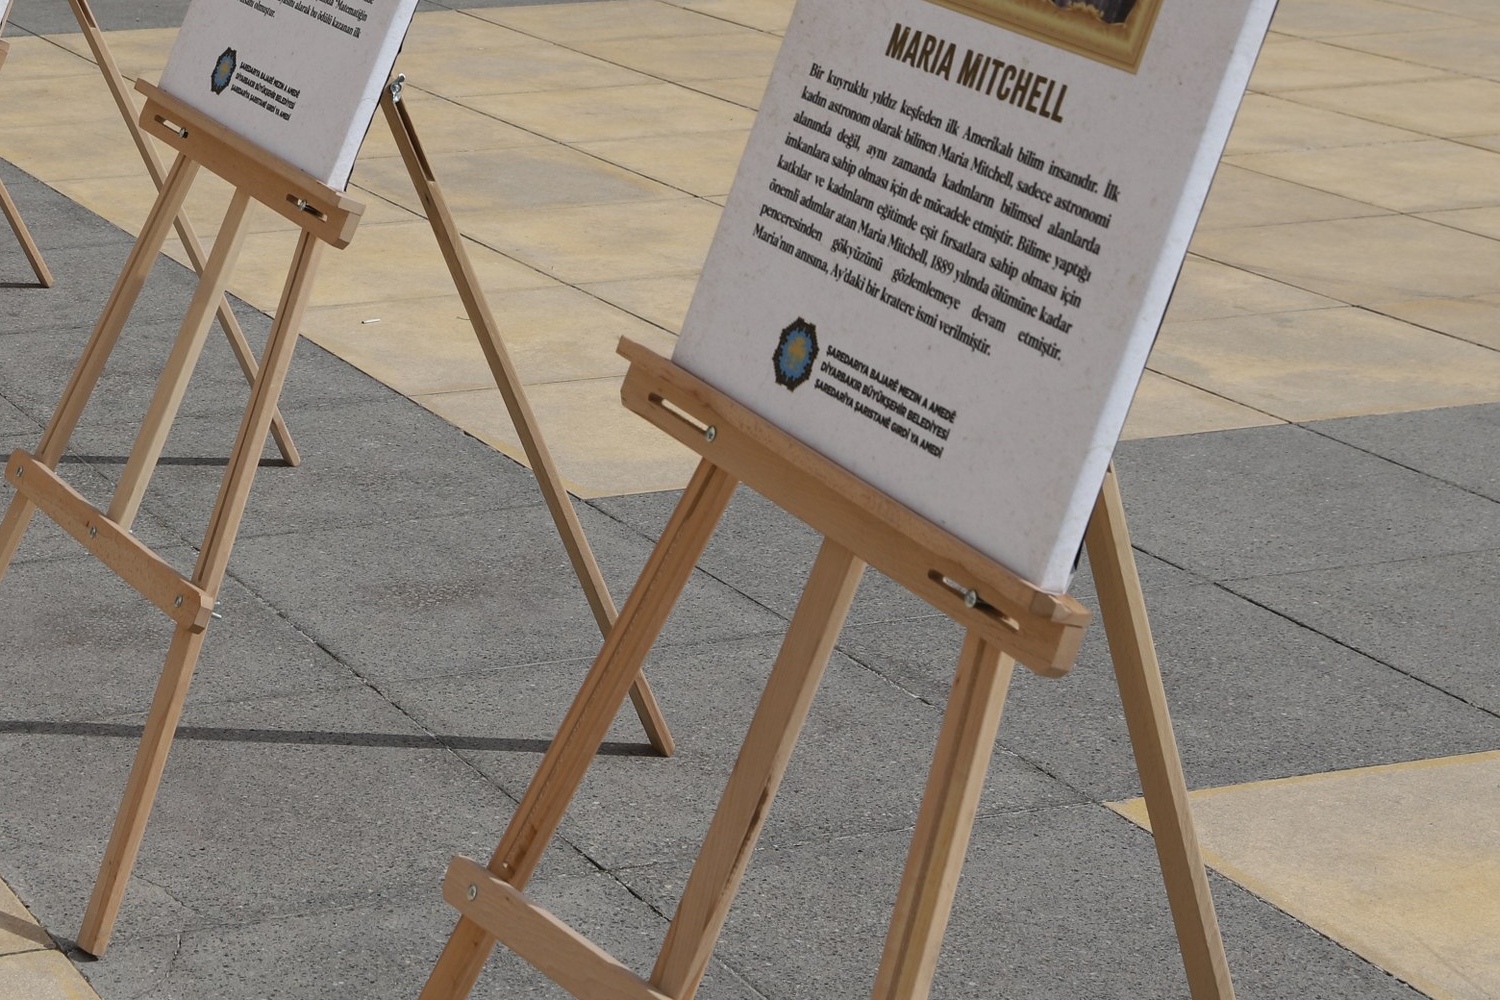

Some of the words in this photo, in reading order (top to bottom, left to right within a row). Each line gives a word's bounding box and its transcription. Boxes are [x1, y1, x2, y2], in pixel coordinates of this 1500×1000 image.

[809, 63, 826, 80] Bir
[827, 70, 869, 99] kuyruklu
[870, 91, 898, 111] yıldız
[900, 100, 943, 130] keşfeden
[945, 119, 960, 137] ilk
[962, 126, 1014, 159] Amerikalı
[1017, 147, 1045, 172] bilim
[1048, 160, 1099, 194] insanıdır.
[1103, 180, 1121, 203] İlk
[886, 23, 957, 82] MARIA
[957, 49, 1068, 124] MITCHELL
[785, 132, 831, 164] imkanlara
[831, 156, 857, 178] sahip
[858, 166, 890, 190] olması
[890, 179, 909, 199] için
[910, 188, 923, 205] de
[923, 198, 972, 227] mücadele
[973, 220, 1014, 247] etmiştir.
[1017, 236, 1053, 264] Bilime
[793, 111, 833, 137] alanında
[866, 145, 888, 162] aynı
[892, 156, 937, 184] zamanda
[942, 173, 995, 209] kadınların
[1000, 198, 1044, 230] bilimsel
[1047, 222, 1101, 256] alanlarda
[801, 86, 828, 109] kadın
[828, 101, 872, 127] astronom
[872, 117, 903, 141] olarak
[904, 129, 938, 156] bilinen
[938, 144, 970, 169] Maria
[970, 157, 1015, 190] Mitchell,
[1016, 181, 1054, 204] sadece
[1054, 197, 1113, 229] astronomi
[759, 204, 823, 242] penceresinden
[830, 238, 884, 272] gökyüzünü
[891, 268, 961, 310] gözlemlemeye
[972, 305, 1007, 334] devam
[1018, 331, 1062, 361] etmiştir.
[769, 178, 801, 203] önemli
[799, 195, 836, 220] adımlar
[835, 213, 858, 231] atan
[858, 220, 887, 246] Maria
[887, 234, 929, 267] Mitchell,
[930, 255, 955, 276] 1889
[953, 270, 990, 295] yılında
[991, 284, 1039, 318] ölümüne
[1039, 306, 1074, 335] kadar
[777, 155, 813, 182] katkılar
[815, 175, 826, 188] ve
[827, 177, 875, 212] kadınların
[920, 225, 939, 241] eşit
[940, 230, 987, 264] fırsatlara
[989, 257, 1019, 281] sahip
[1021, 270, 1059, 297] olması
[1060, 286, 1082, 309] için
[795, 249, 829, 275] anısına,
[865, 279, 881, 298] bir
[880, 287, 916, 317] kratere
[915, 306, 939, 329] ismi
[939, 321, 991, 357] verilmiştir.
